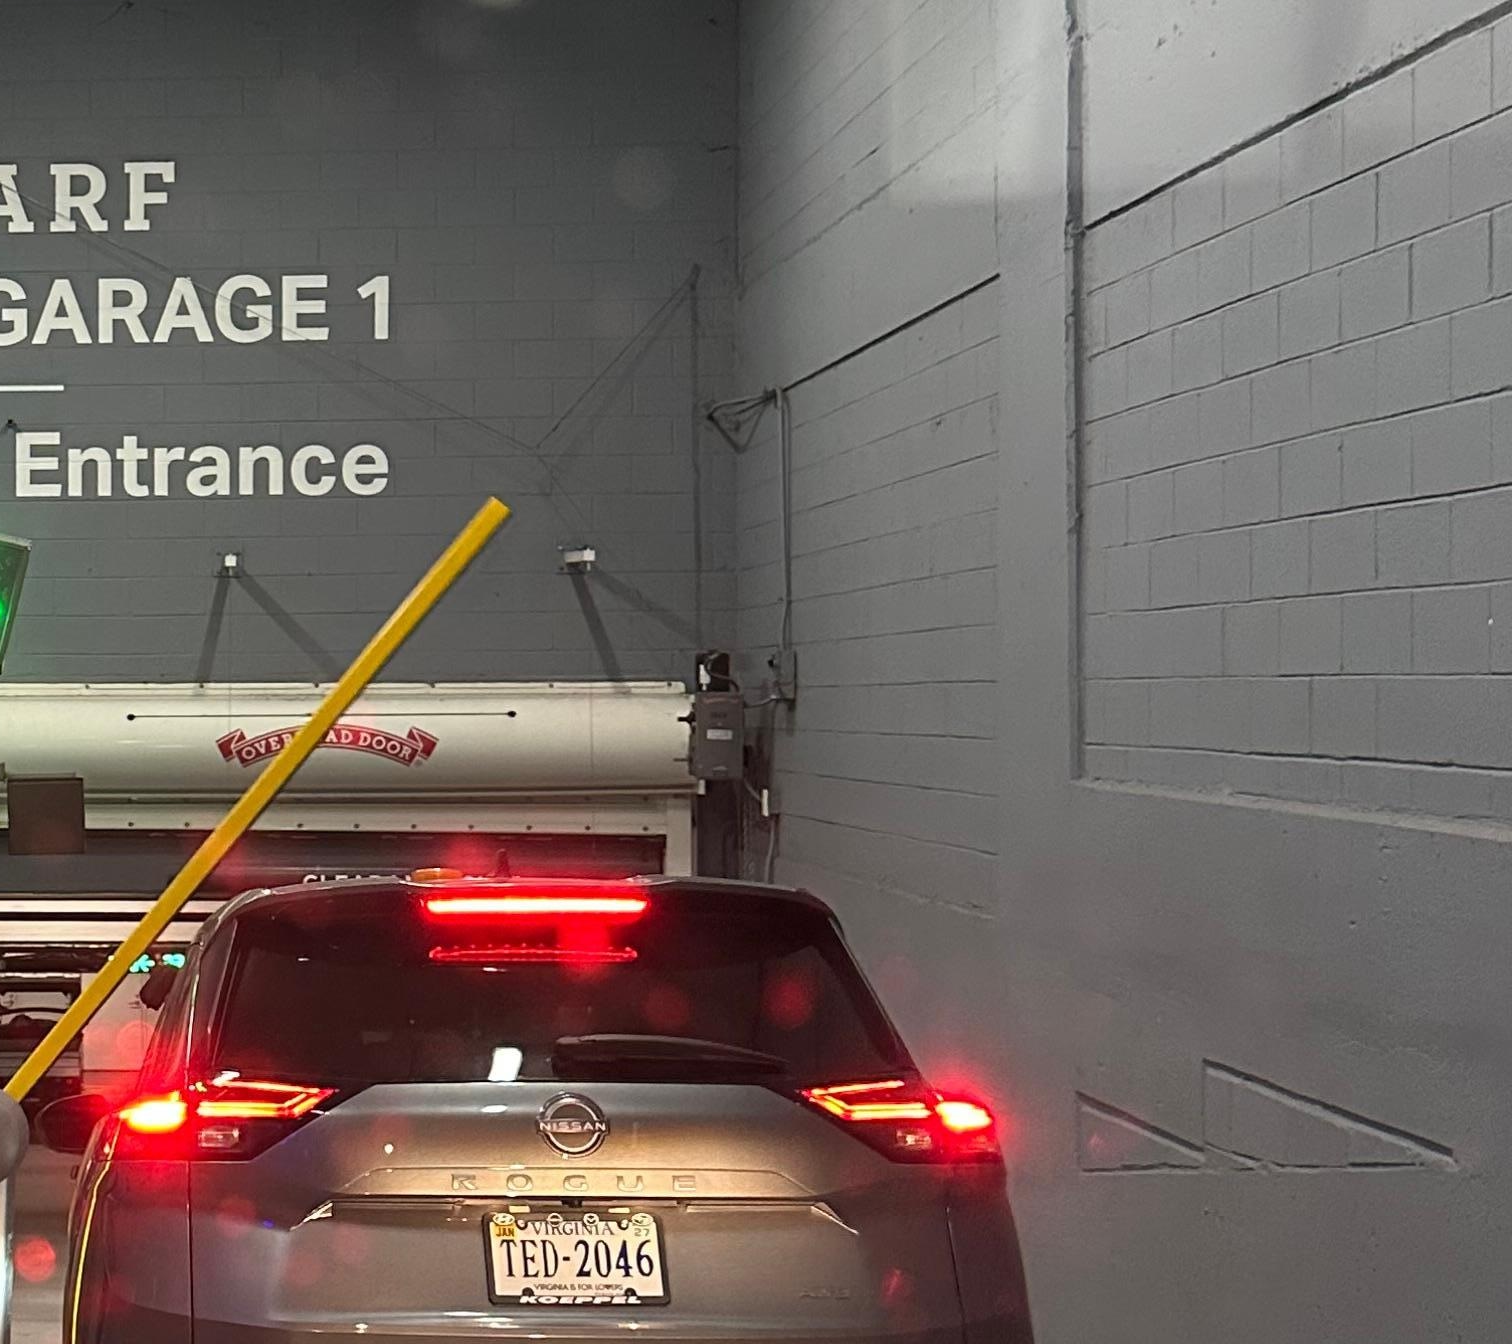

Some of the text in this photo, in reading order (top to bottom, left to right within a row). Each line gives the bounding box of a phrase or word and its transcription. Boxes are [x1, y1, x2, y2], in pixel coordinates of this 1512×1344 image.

[358, 275, 391, 341] 1
[15, 431, 389, 498] Entrance
[241, 729, 411, 761] OVERAD DOOR
[540, 1121, 606, 1132] NISSAN
[451, 1174, 696, 1192] ROGUE
[496, 1227, 514, 1237] JAN
[634, 1228, 650, 1237] 27
[500, 1239, 654, 1278] TED-2046
[519, 1295, 642, 1304] KOEPPEL
